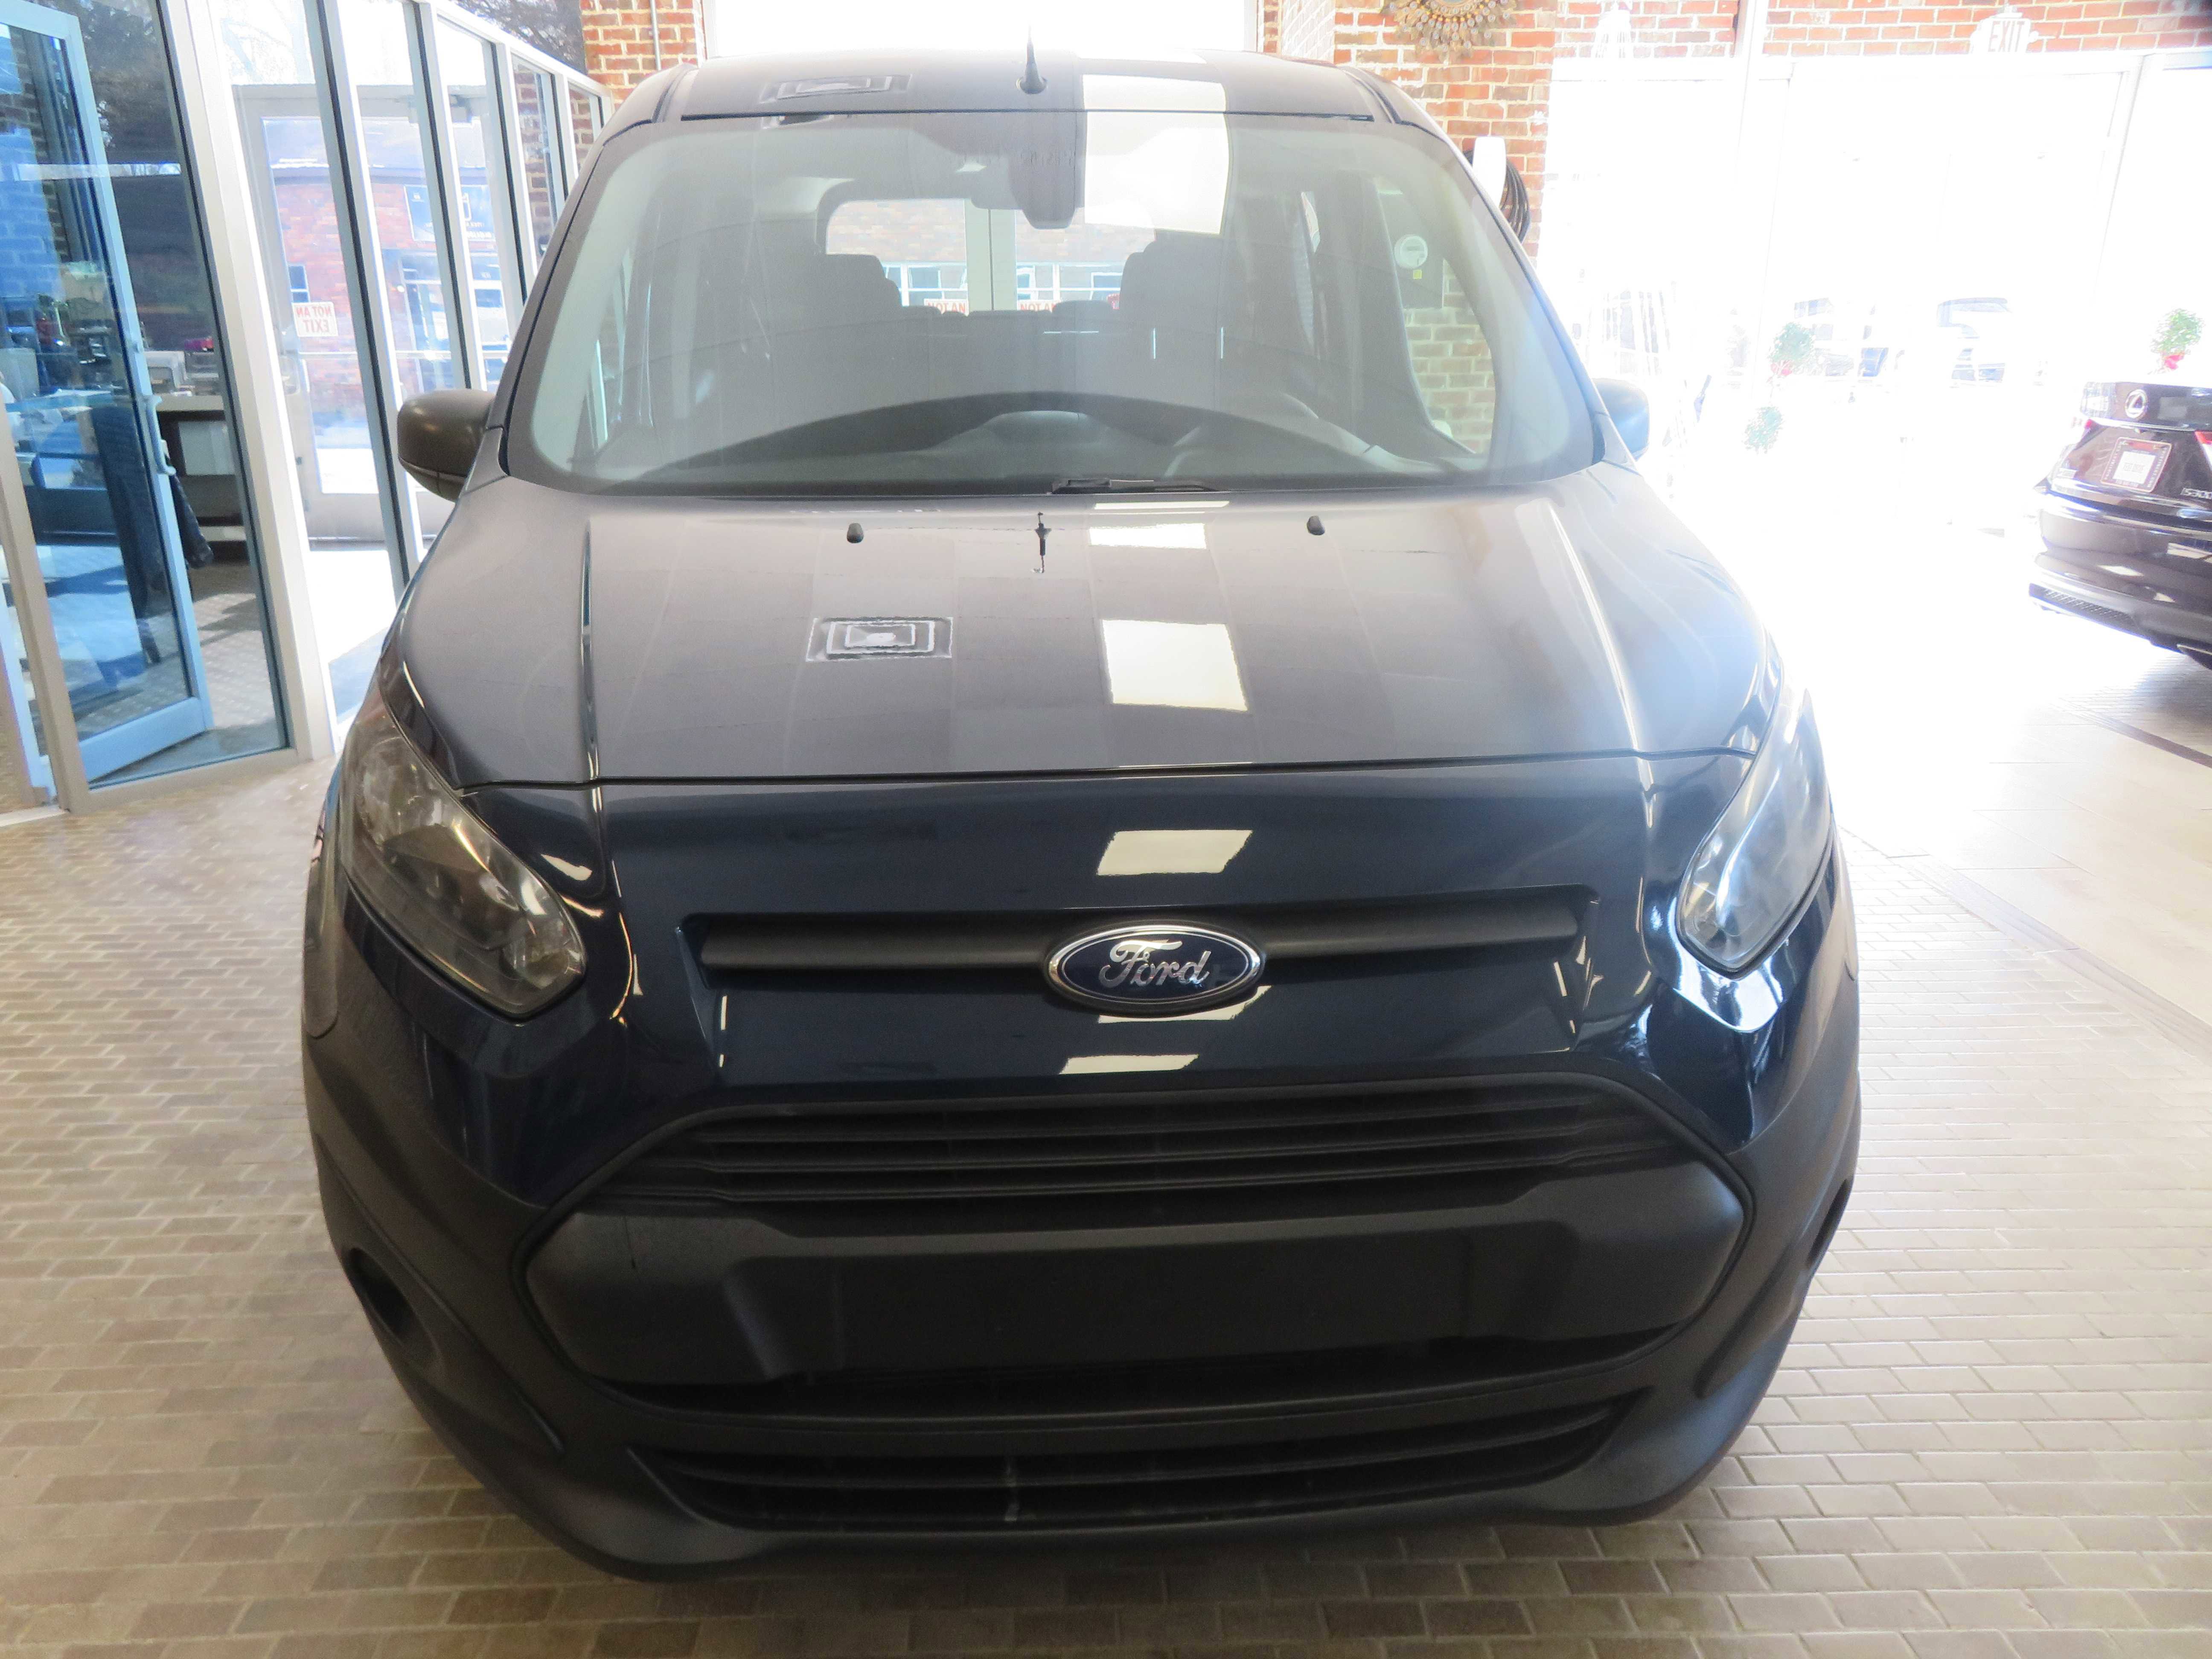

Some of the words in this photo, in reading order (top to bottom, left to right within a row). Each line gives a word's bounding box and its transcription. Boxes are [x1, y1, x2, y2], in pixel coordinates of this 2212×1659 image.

[1988, 20, 2026, 52] EXIT
[952, 302, 966, 314] AN
[1020, 303, 1042, 311] NOT
[1099, 940, 1211, 988] Ford
